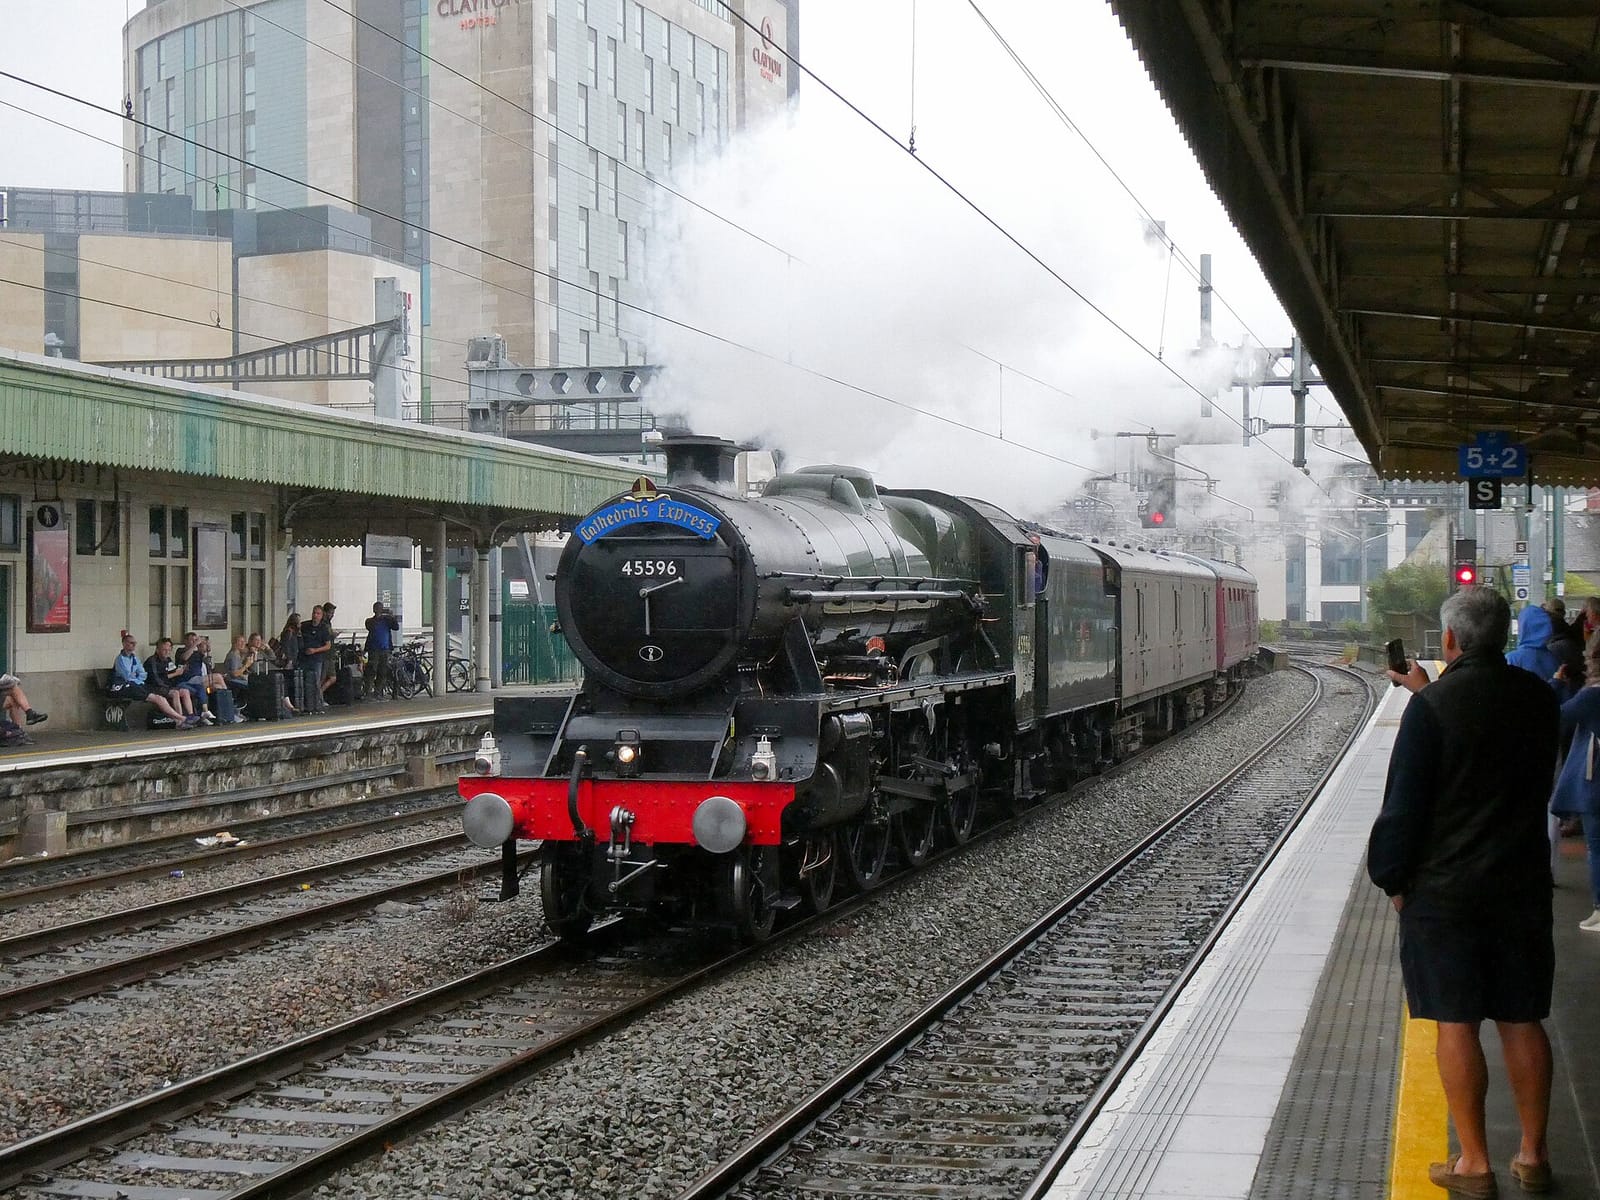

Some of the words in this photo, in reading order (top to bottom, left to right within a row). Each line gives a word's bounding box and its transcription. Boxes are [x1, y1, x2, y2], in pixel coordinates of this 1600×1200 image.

[459, 16, 497, 30] HOTEL
[753, 47, 781, 77] CLAYTON
[1477, 481, 1494, 501] S
[580, 503, 649, 541] Cathedrals
[658, 502, 714, 534] Express
[621, 560, 677, 576] 45596
[105, 705, 123, 723] GWR
